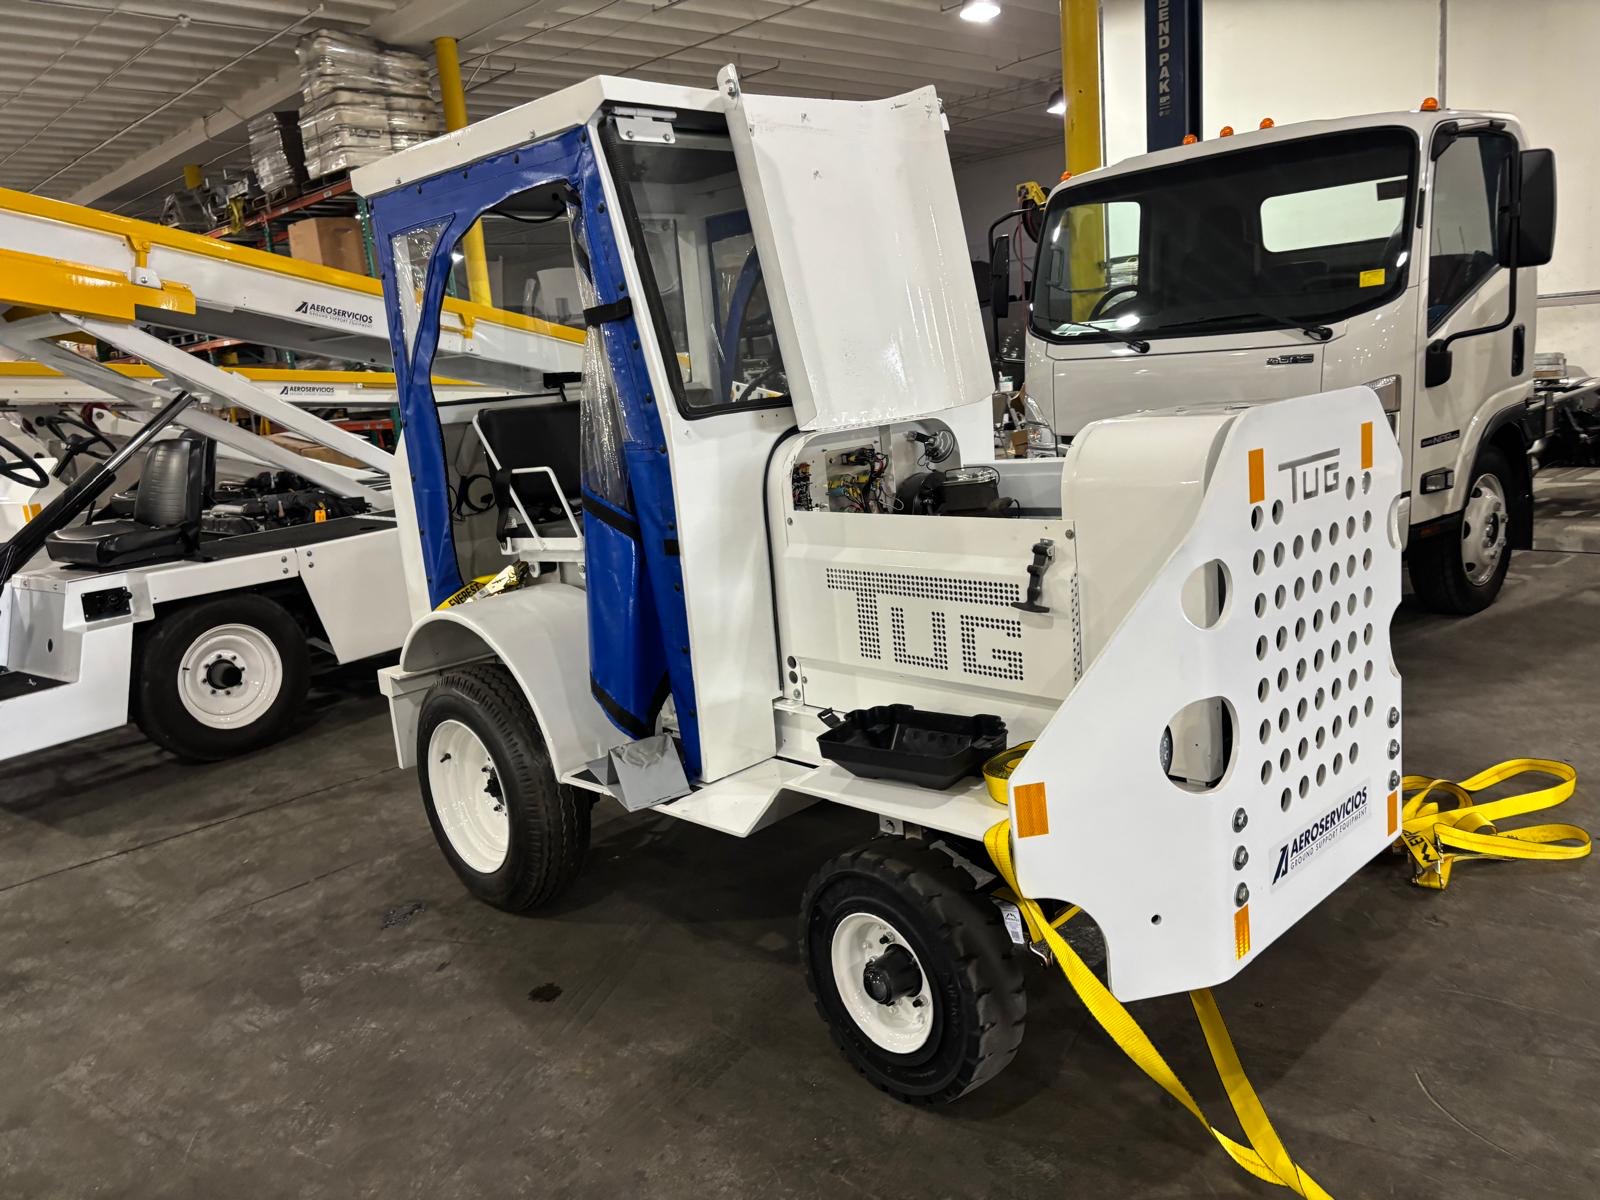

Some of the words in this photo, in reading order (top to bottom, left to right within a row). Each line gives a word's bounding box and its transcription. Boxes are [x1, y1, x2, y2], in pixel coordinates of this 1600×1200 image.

[309, 303, 373, 324] AEROSERVICIOS
[1278, 447, 1340, 504] TUG
[448, 581, 480, 607] EVEREST
[826, 567, 1025, 681] TUG
[1290, 786, 1367, 858] AEROSERVICIOS
[1290, 847, 1314, 870] GROUND
[1315, 828, 1338, 851] SUPPORT
[1339, 807, 1367, 833] EQUIPMENT
